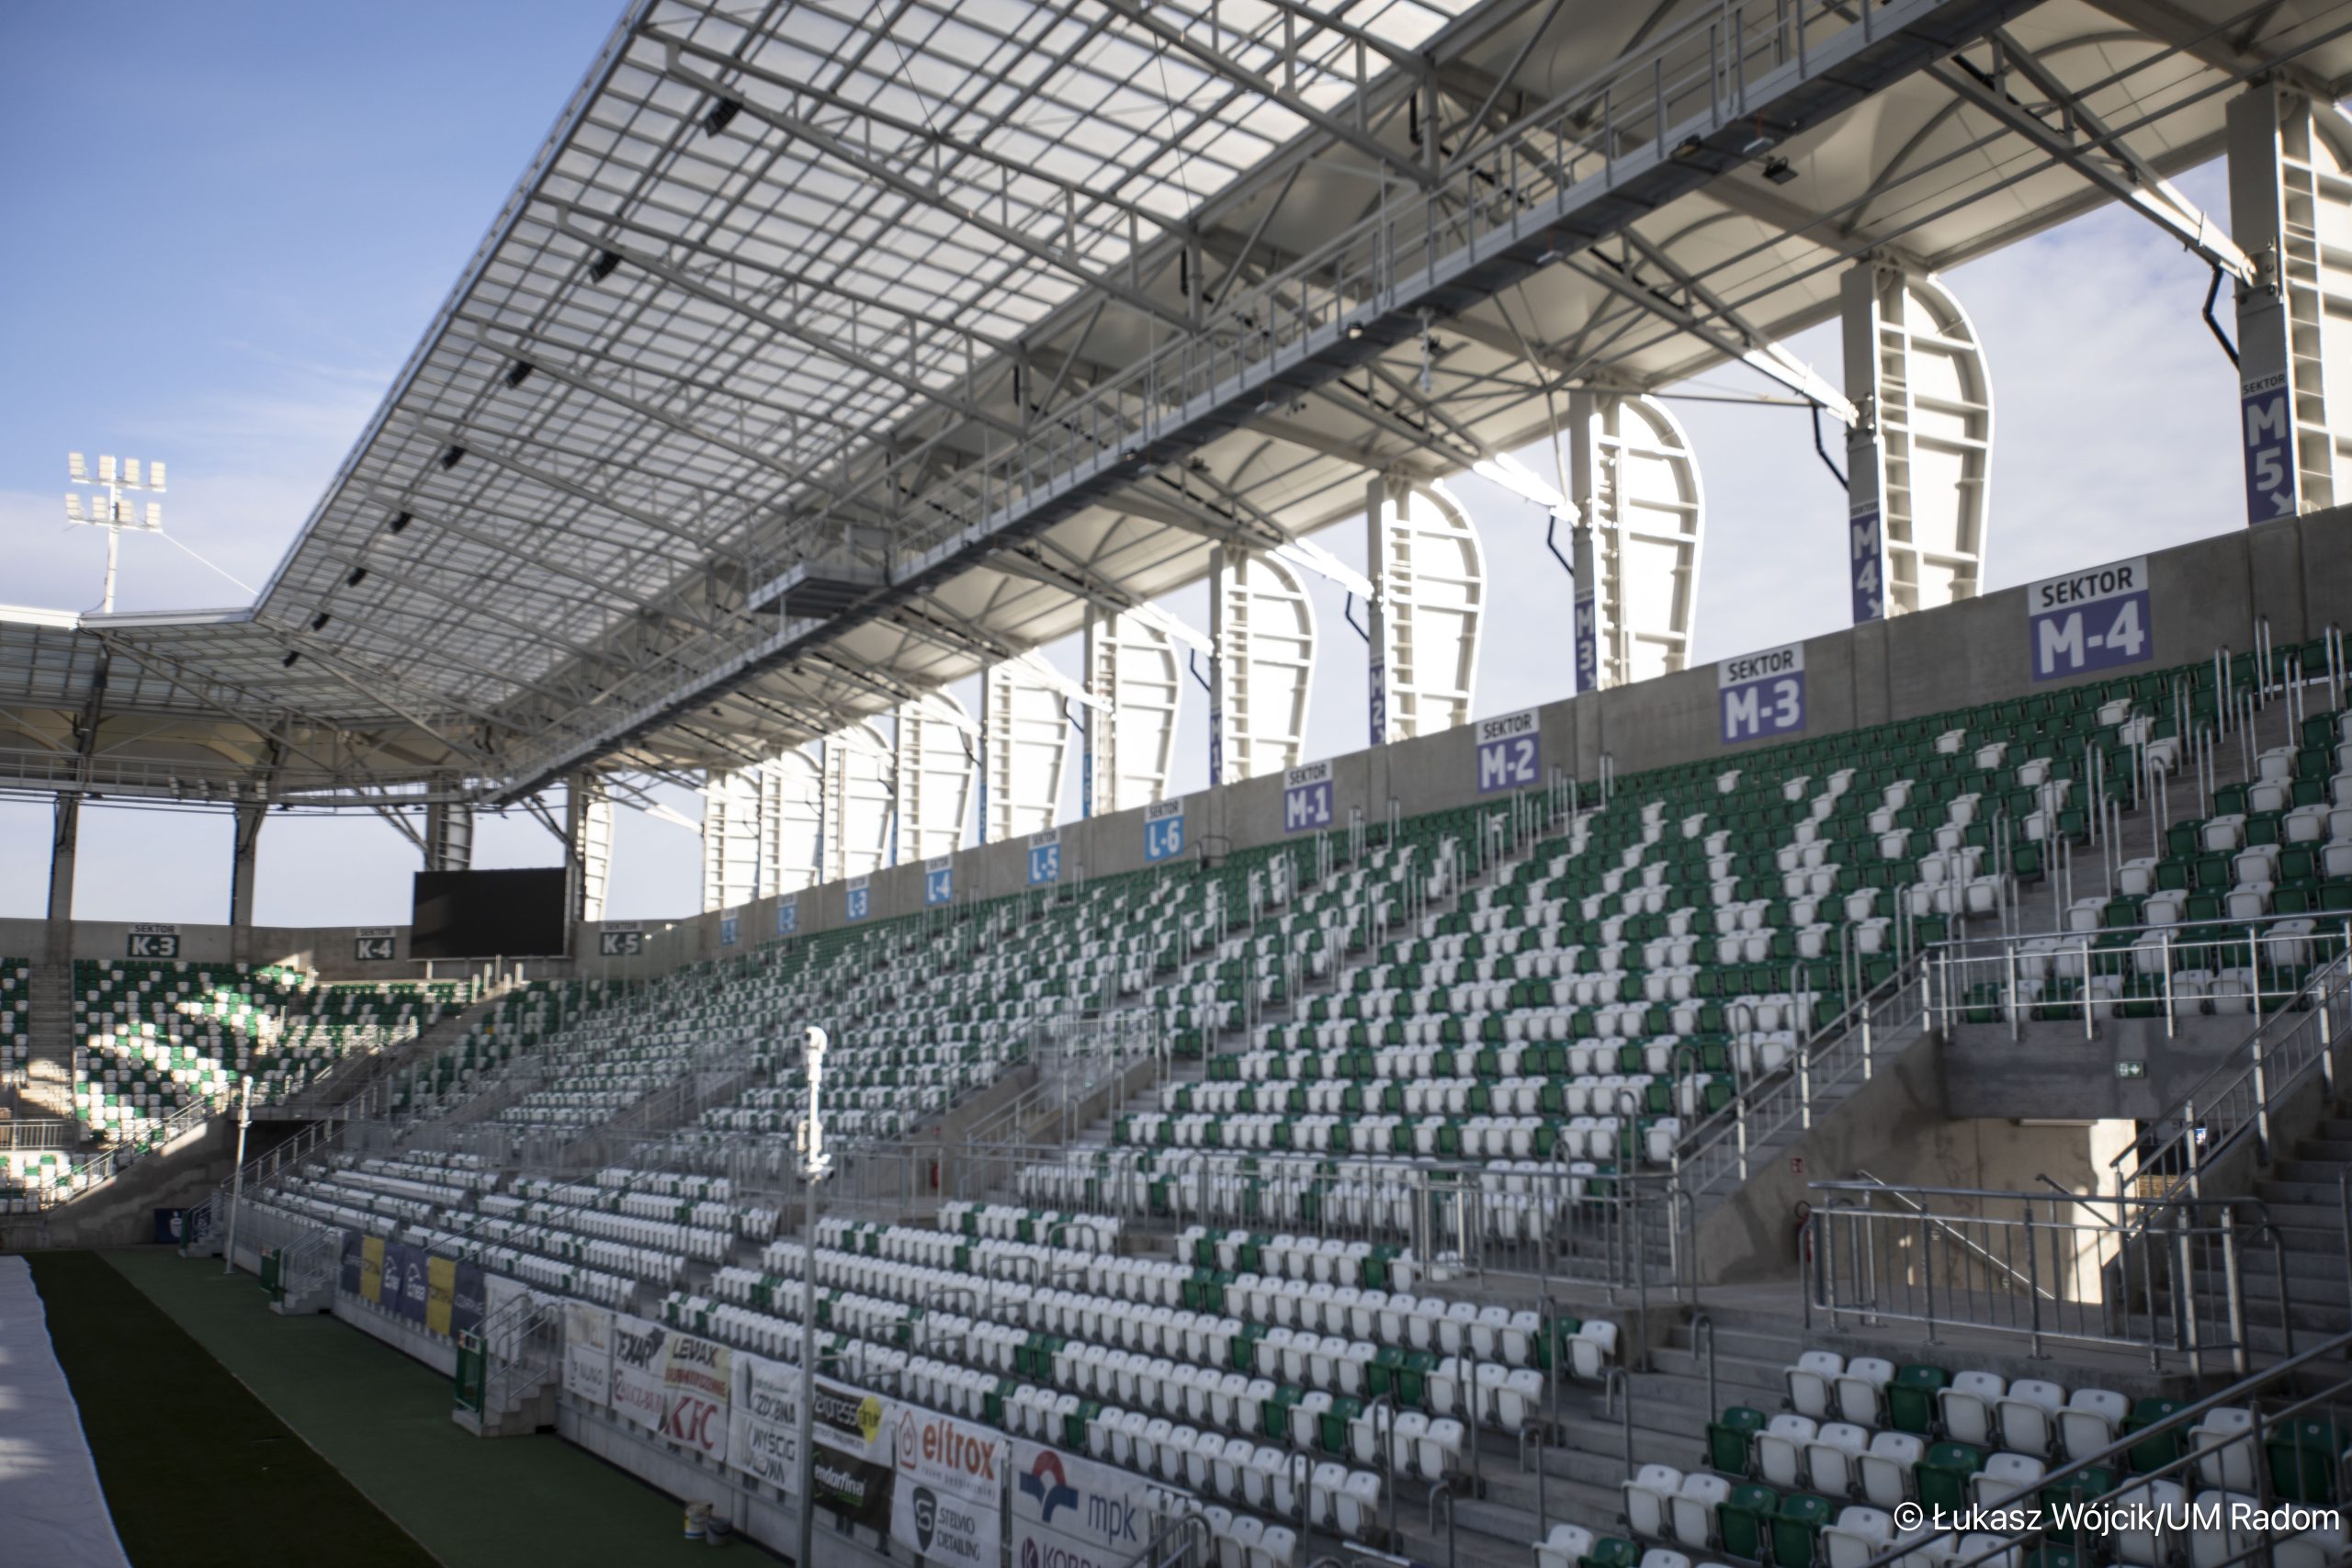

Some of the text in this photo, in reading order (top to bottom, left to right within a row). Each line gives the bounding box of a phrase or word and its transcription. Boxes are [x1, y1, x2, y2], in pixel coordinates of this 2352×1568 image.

[2243, 373, 2287, 395] SEKTOR
[2041, 567, 2133, 608] SEKTOR
[2039, 601, 2145, 674] M-4
[1728, 650, 1794, 682] SEKTOR
[1724, 679, 1801, 739] M-3
[1483, 713, 1532, 740] SEKTOR
[1289, 762, 1329, 786] SEKTOR
[1479, 739, 1535, 790] M-2
[1286, 784, 1331, 828] M-1
[1148, 820, 1180, 858] L-6
[1032, 847, 1058, 883] L-5
[928, 871, 952, 902] L-4
[847, 890, 868, 919] L-3
[134, 924, 175, 934] SEKTOR
[603, 933, 639, 954] K-5
[131, 936, 175, 957] K-3
[356, 938, 392, 960] K-4
[664, 1396, 718, 1450] KFC
[922, 1419, 995, 1482] eltrox
[938, 1506, 976, 1536] STELVIO
[1088, 1493, 1137, 1546] mpk
